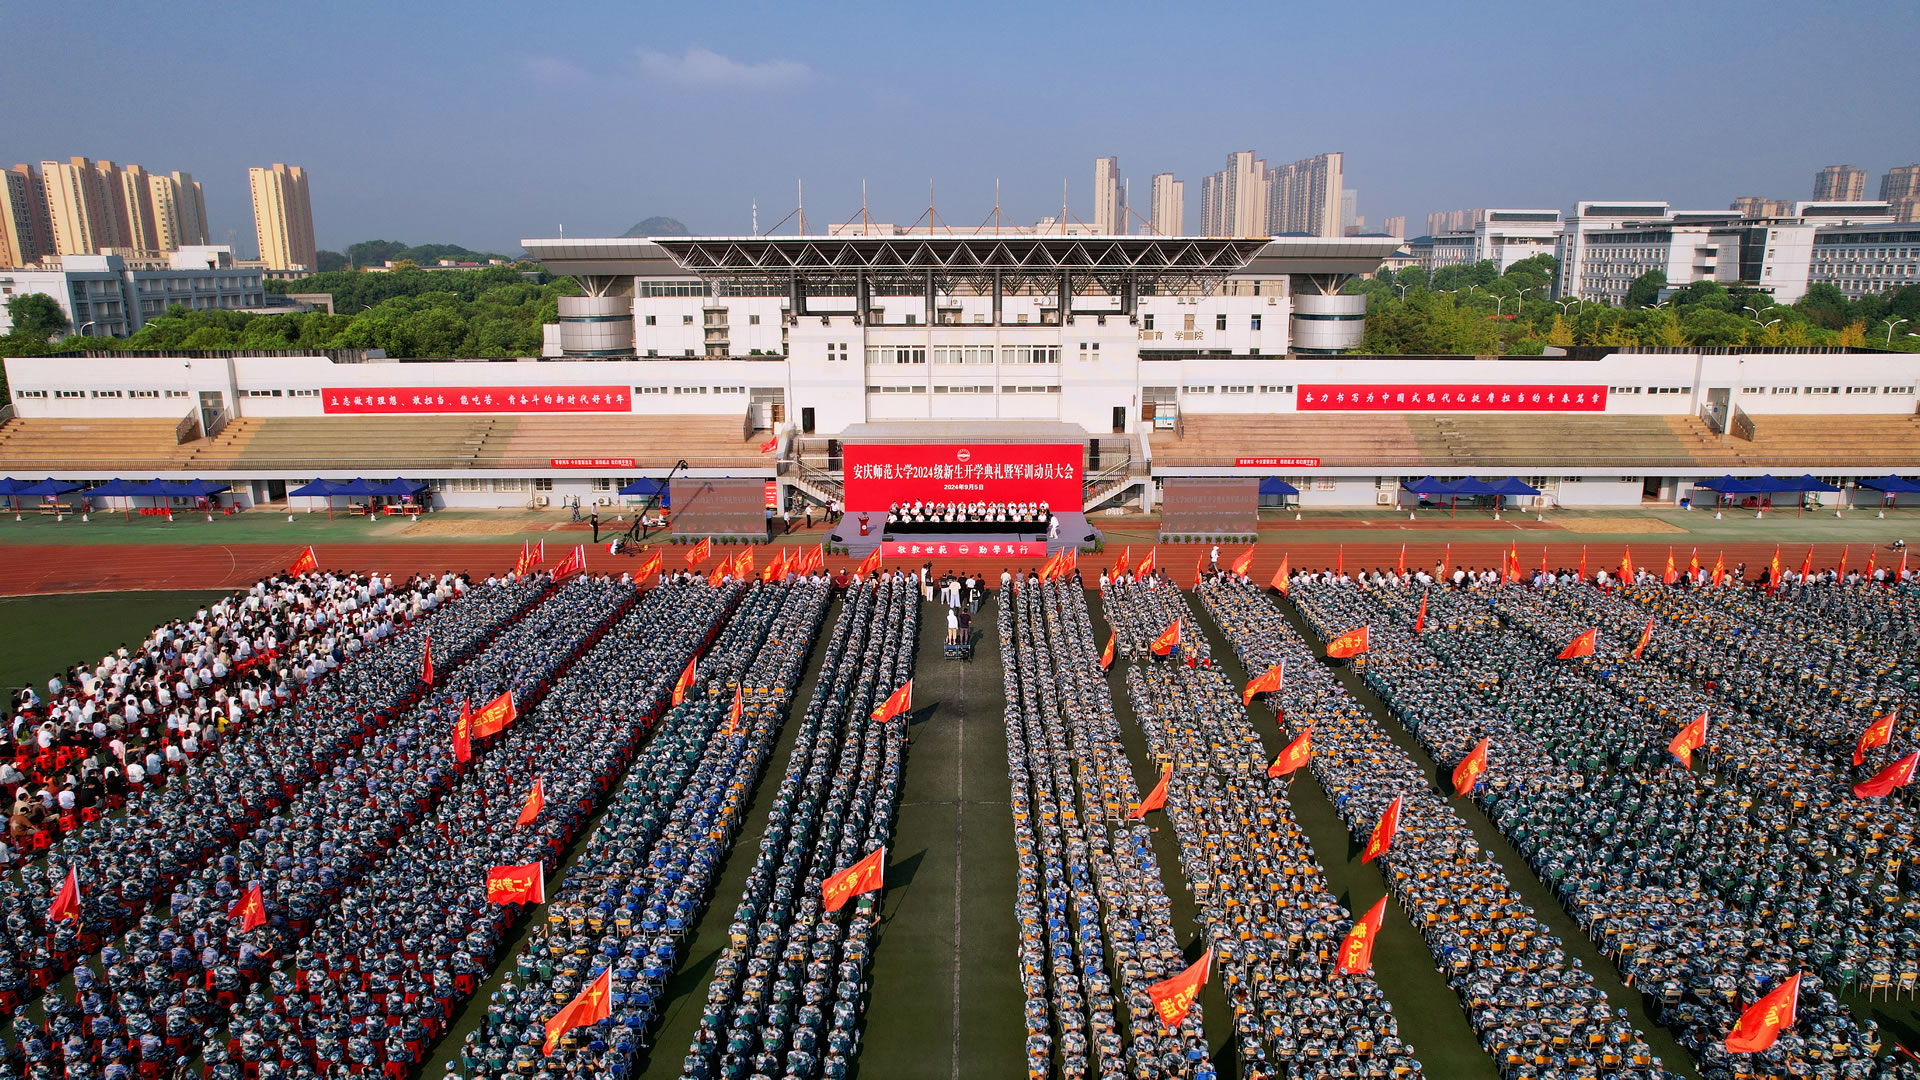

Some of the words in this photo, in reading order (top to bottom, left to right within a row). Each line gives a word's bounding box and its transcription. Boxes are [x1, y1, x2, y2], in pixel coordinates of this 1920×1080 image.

[330, 394, 625, 406] 立志做有理想、敢担当、能吃苦、肯奋斗的新时代好青年
[1305, 391, 1600, 404] 奋力书写为中国式现代化挺膺担当的青春篇章
[853, 463, 1074, 480] 安庆师范大学2024级新生开学典礼暨军训动员大会
